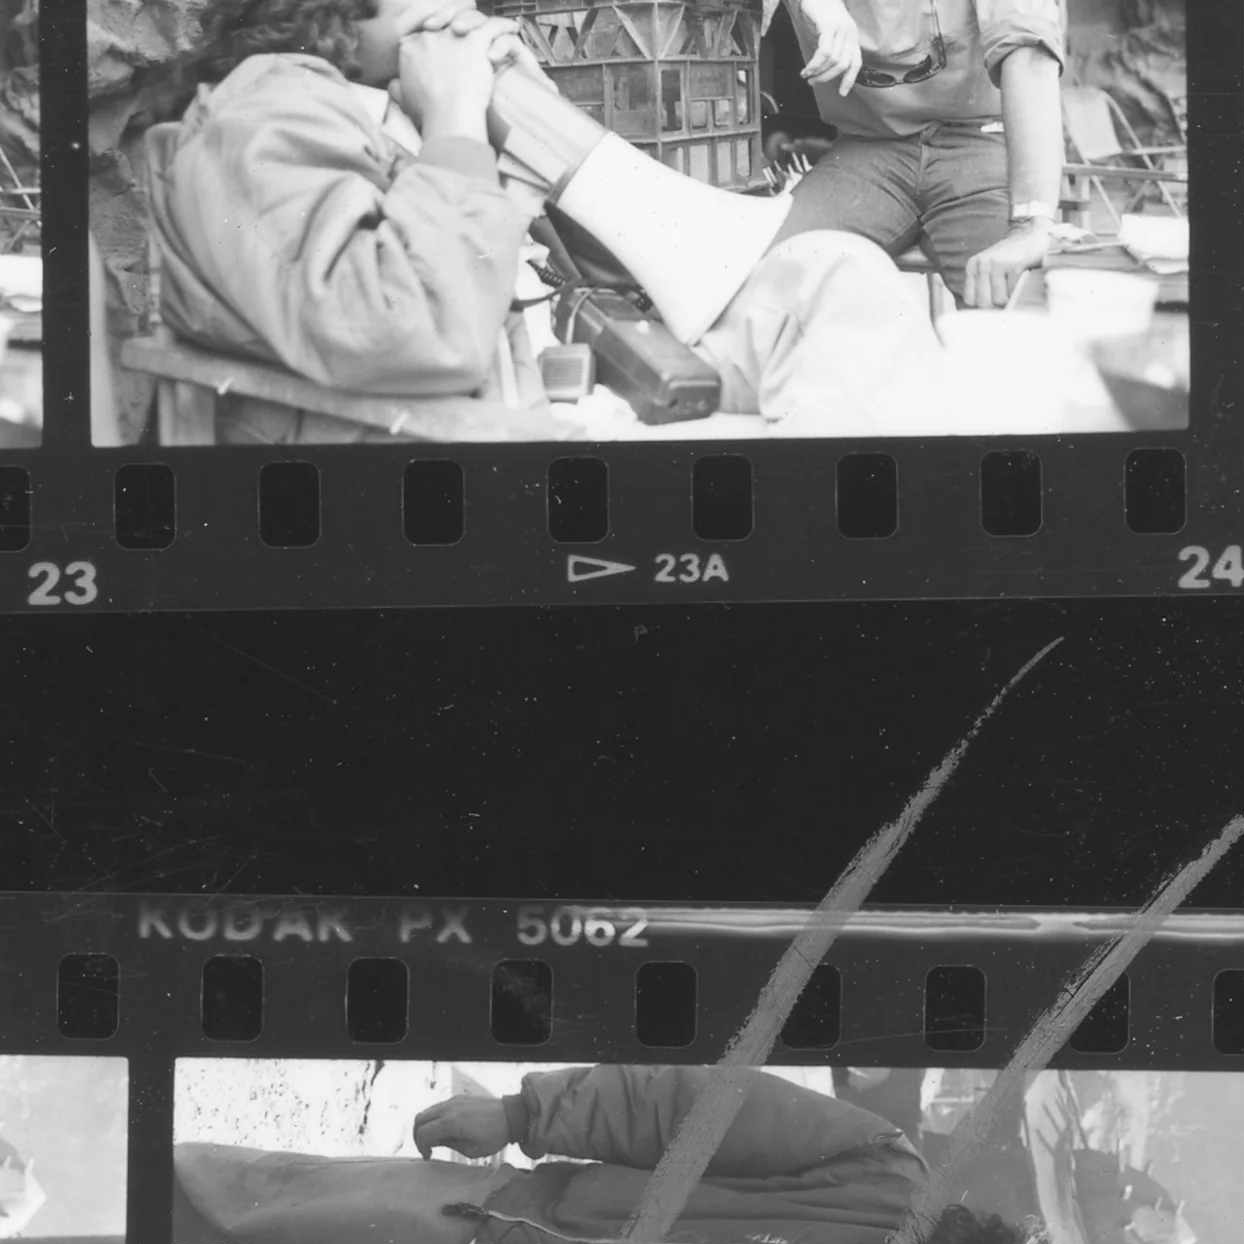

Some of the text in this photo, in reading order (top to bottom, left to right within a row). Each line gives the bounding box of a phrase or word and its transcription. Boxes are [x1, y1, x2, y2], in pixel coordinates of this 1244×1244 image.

[27, 560, 99, 606] 23
[654, 552, 730, 584] 23A
[138, 904, 649, 947] KODAK PX 5062
